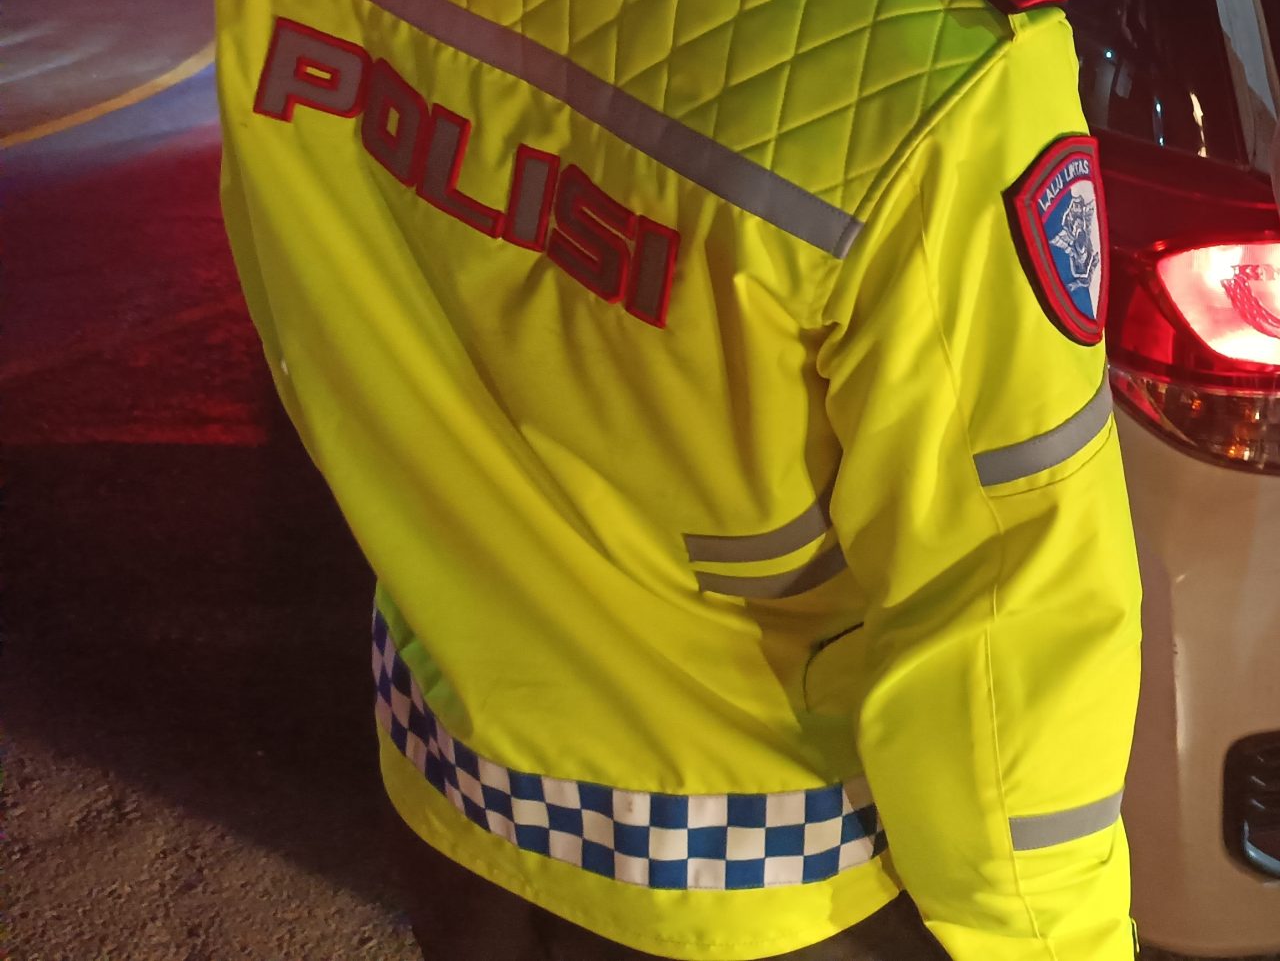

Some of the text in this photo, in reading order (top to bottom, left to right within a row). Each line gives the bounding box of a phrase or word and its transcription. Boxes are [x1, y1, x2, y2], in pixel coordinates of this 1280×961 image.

[253, 16, 681, 329] POLISI
[1038, 159, 1089, 211] LALU LINTAS
